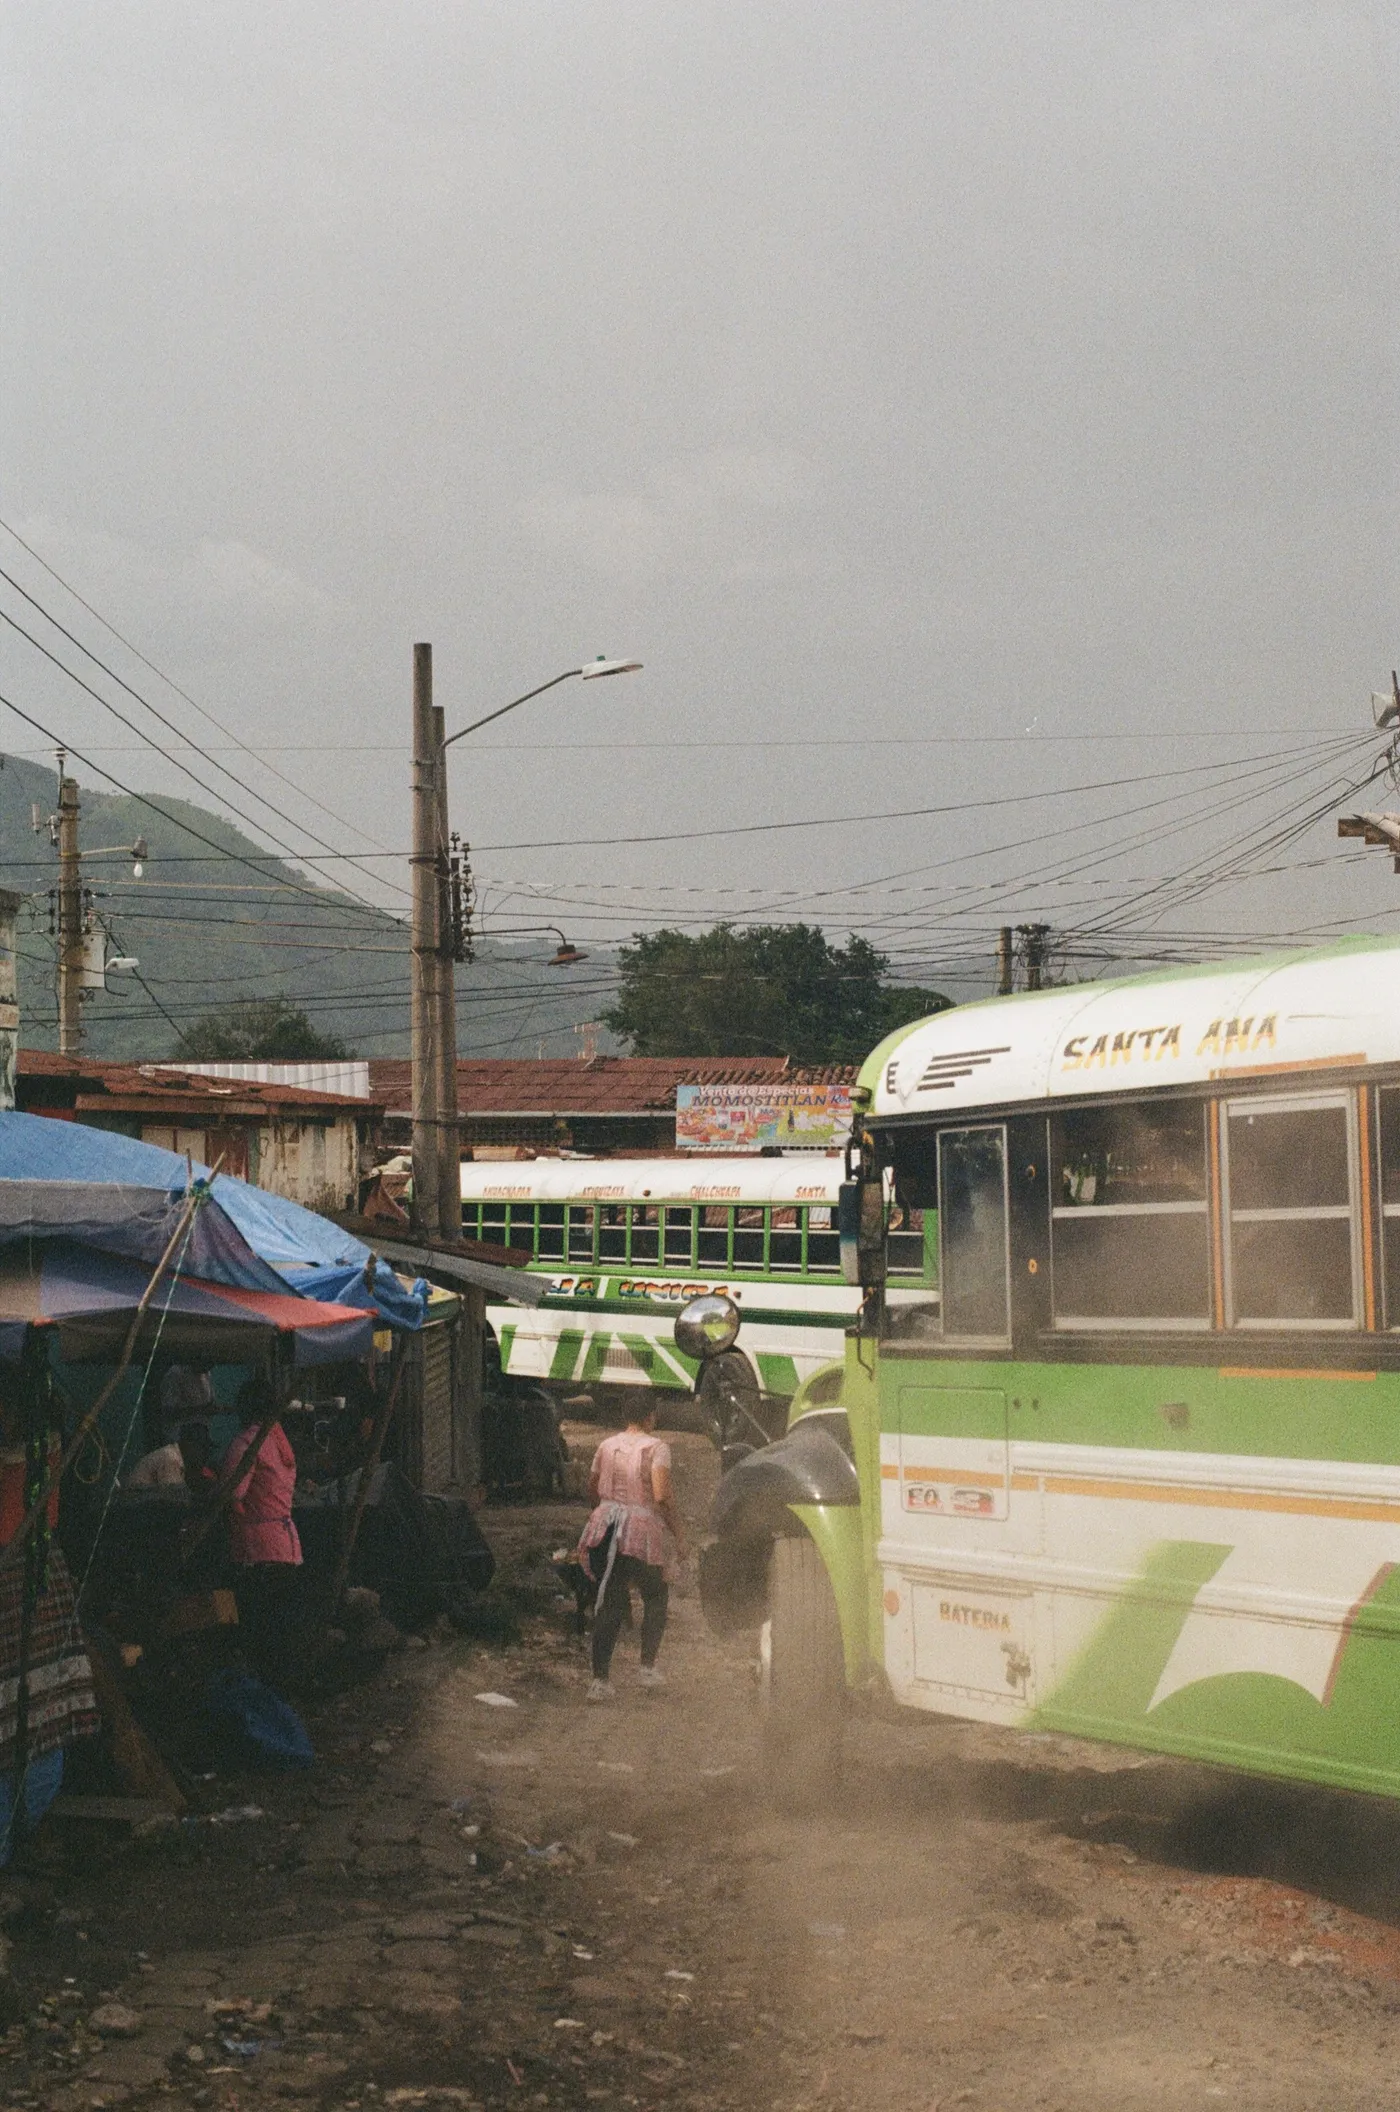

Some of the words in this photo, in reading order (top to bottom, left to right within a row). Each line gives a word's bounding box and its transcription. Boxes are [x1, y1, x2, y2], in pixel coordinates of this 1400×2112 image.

[1062, 1024, 1181, 1072] SANTA
[1196, 1012, 1278, 1057] ANA
[795, 1186, 827, 1198] SANTA
